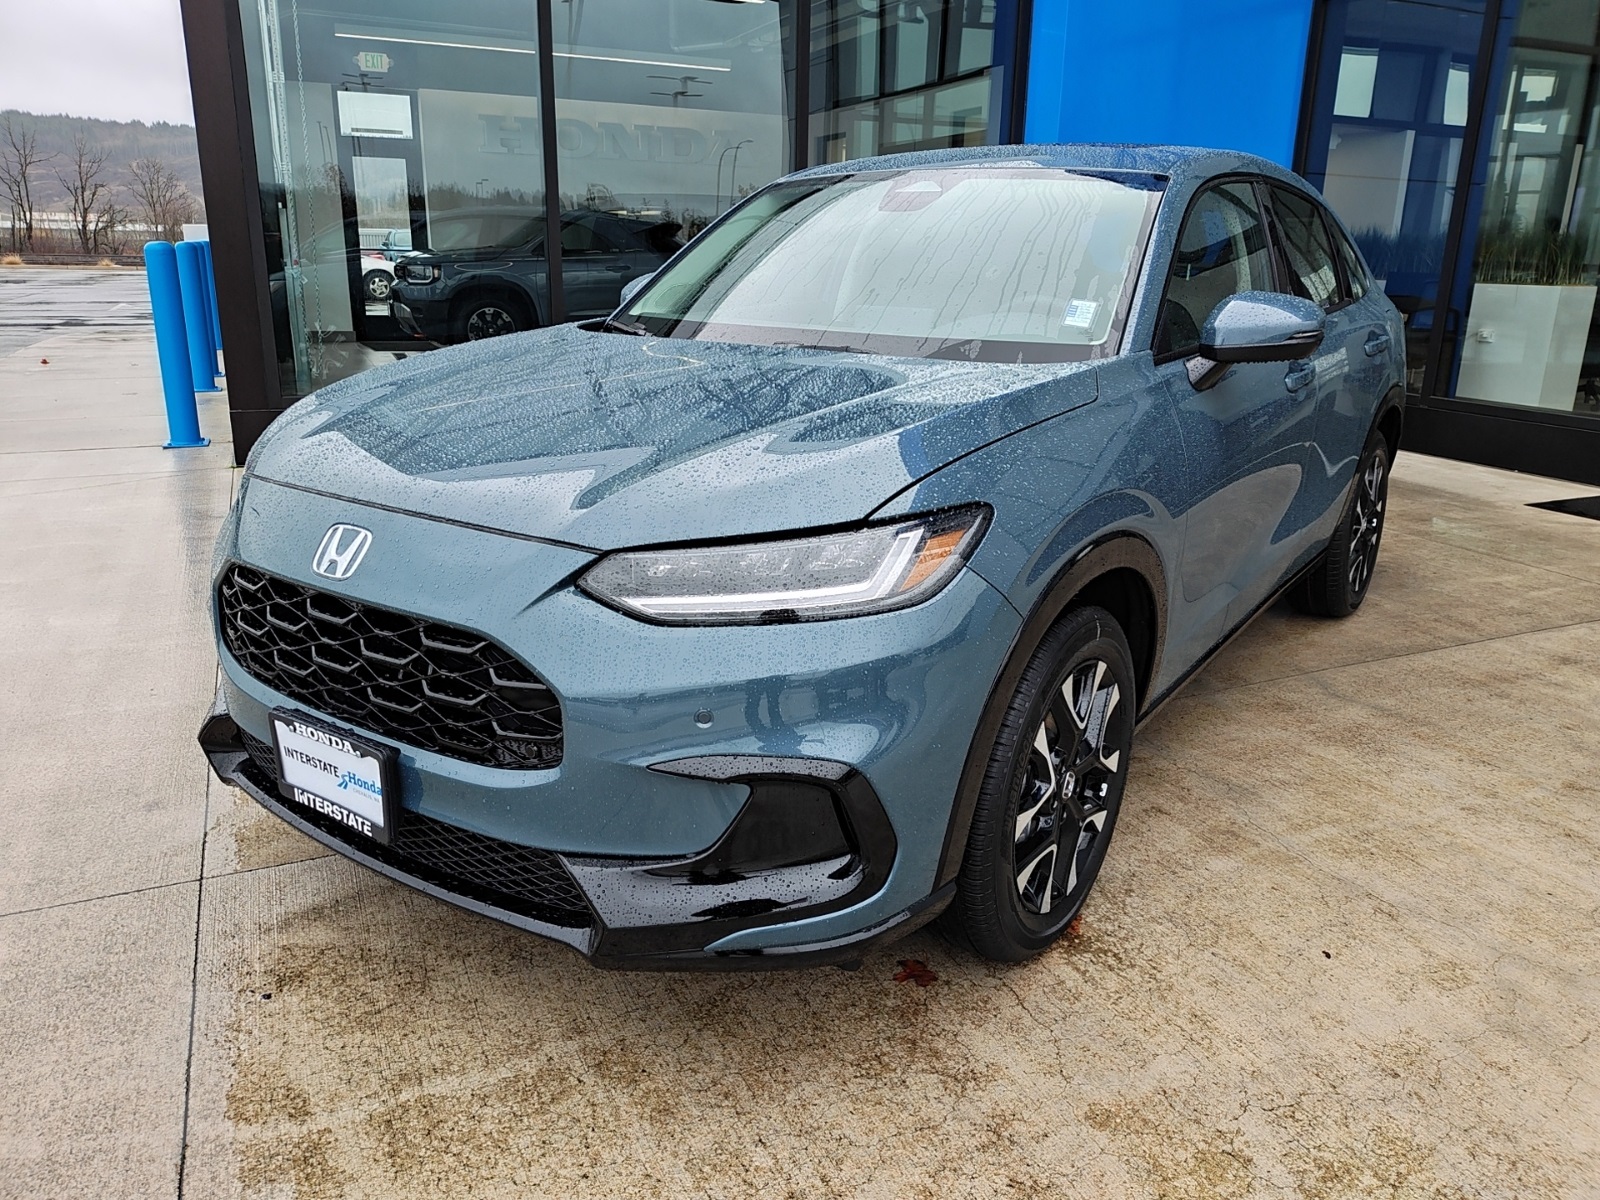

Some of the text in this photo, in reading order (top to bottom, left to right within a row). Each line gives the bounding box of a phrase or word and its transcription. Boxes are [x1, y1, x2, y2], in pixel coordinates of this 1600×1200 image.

[364, 53, 384, 69] EXIT
[477, 113, 762, 166] HONDA
[293, 721, 354, 753] HONDA
[283, 745, 340, 778] INTERSTATE
[347, 771, 383, 796] Honda
[293, 787, 373, 837] INTERSTATE
